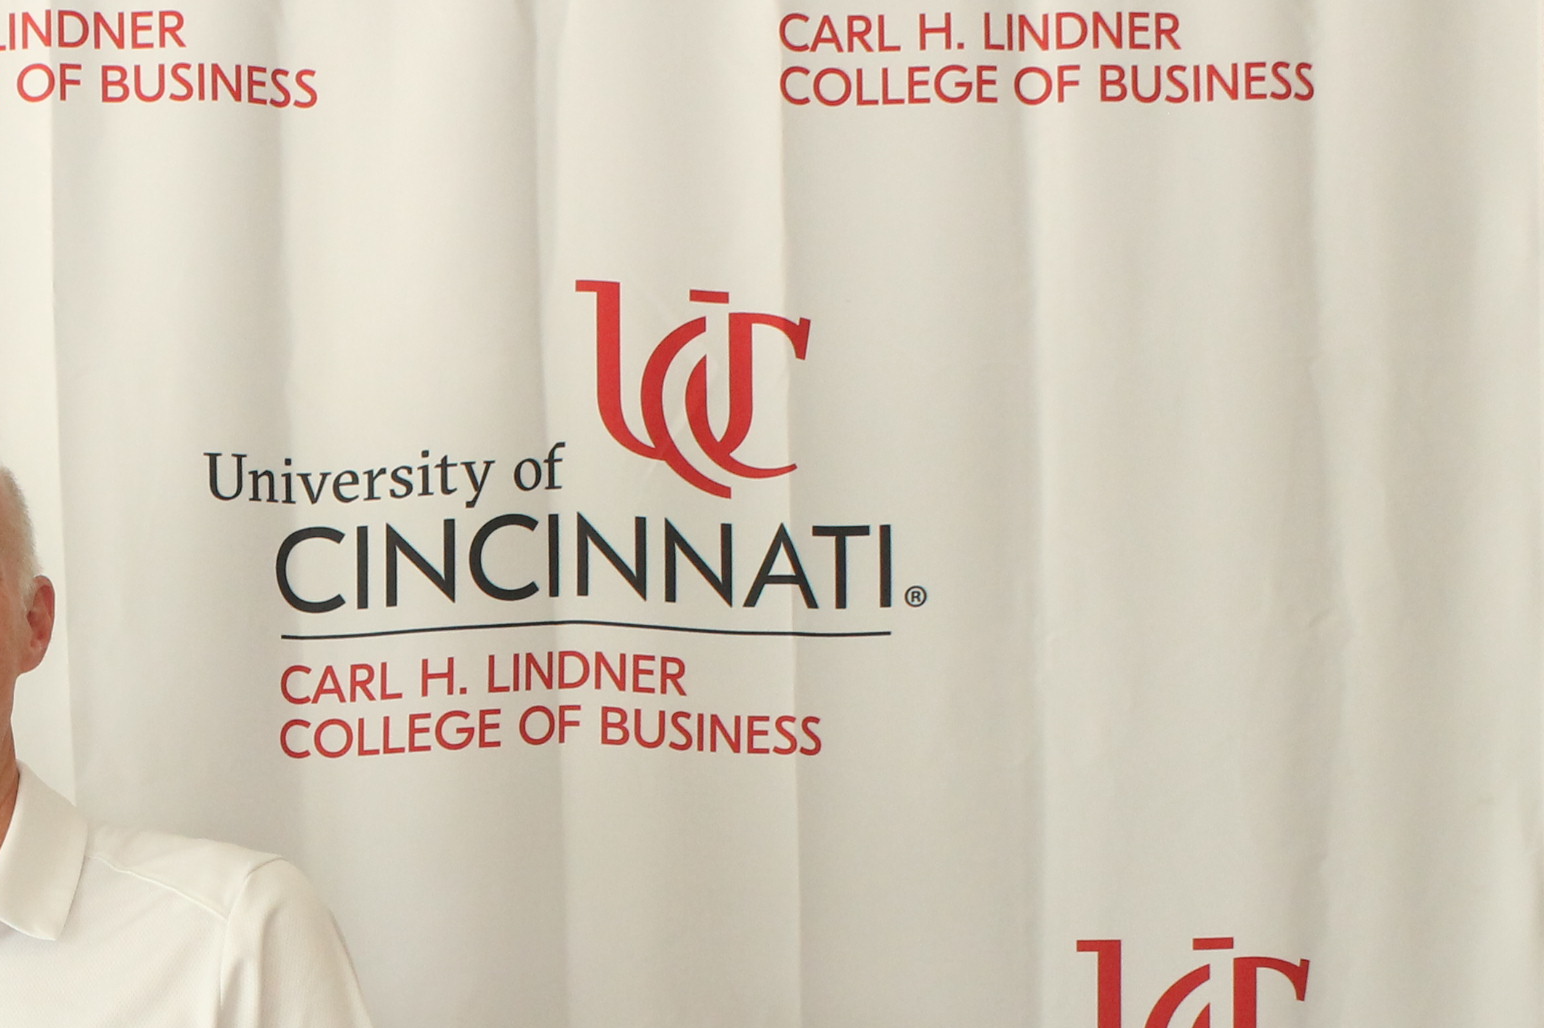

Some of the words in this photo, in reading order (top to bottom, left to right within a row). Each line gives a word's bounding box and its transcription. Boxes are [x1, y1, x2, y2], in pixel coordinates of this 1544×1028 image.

[778, 12, 902, 54] CARL
[918, 12, 966, 51] H.
[983, 11, 1183, 53] LINDNER
[16, 63, 83, 104] OF
[100, 62, 319, 109] BUSINESS
[779, 64, 999, 107] COLLEGE
[1013, 64, 1081, 107] OF
[1099, 61, 1315, 104] BUSINESS
[203, 449, 496, 509] University
[513, 441, 566, 492] of
[280, 661, 405, 706] CARL
[421, 656, 468, 697] H.
[487, 650, 687, 697] LINDNER
[279, 708, 503, 759] COLLEGE
[518, 704, 583, 746] OF
[600, 705, 823, 757] BUSINESS
